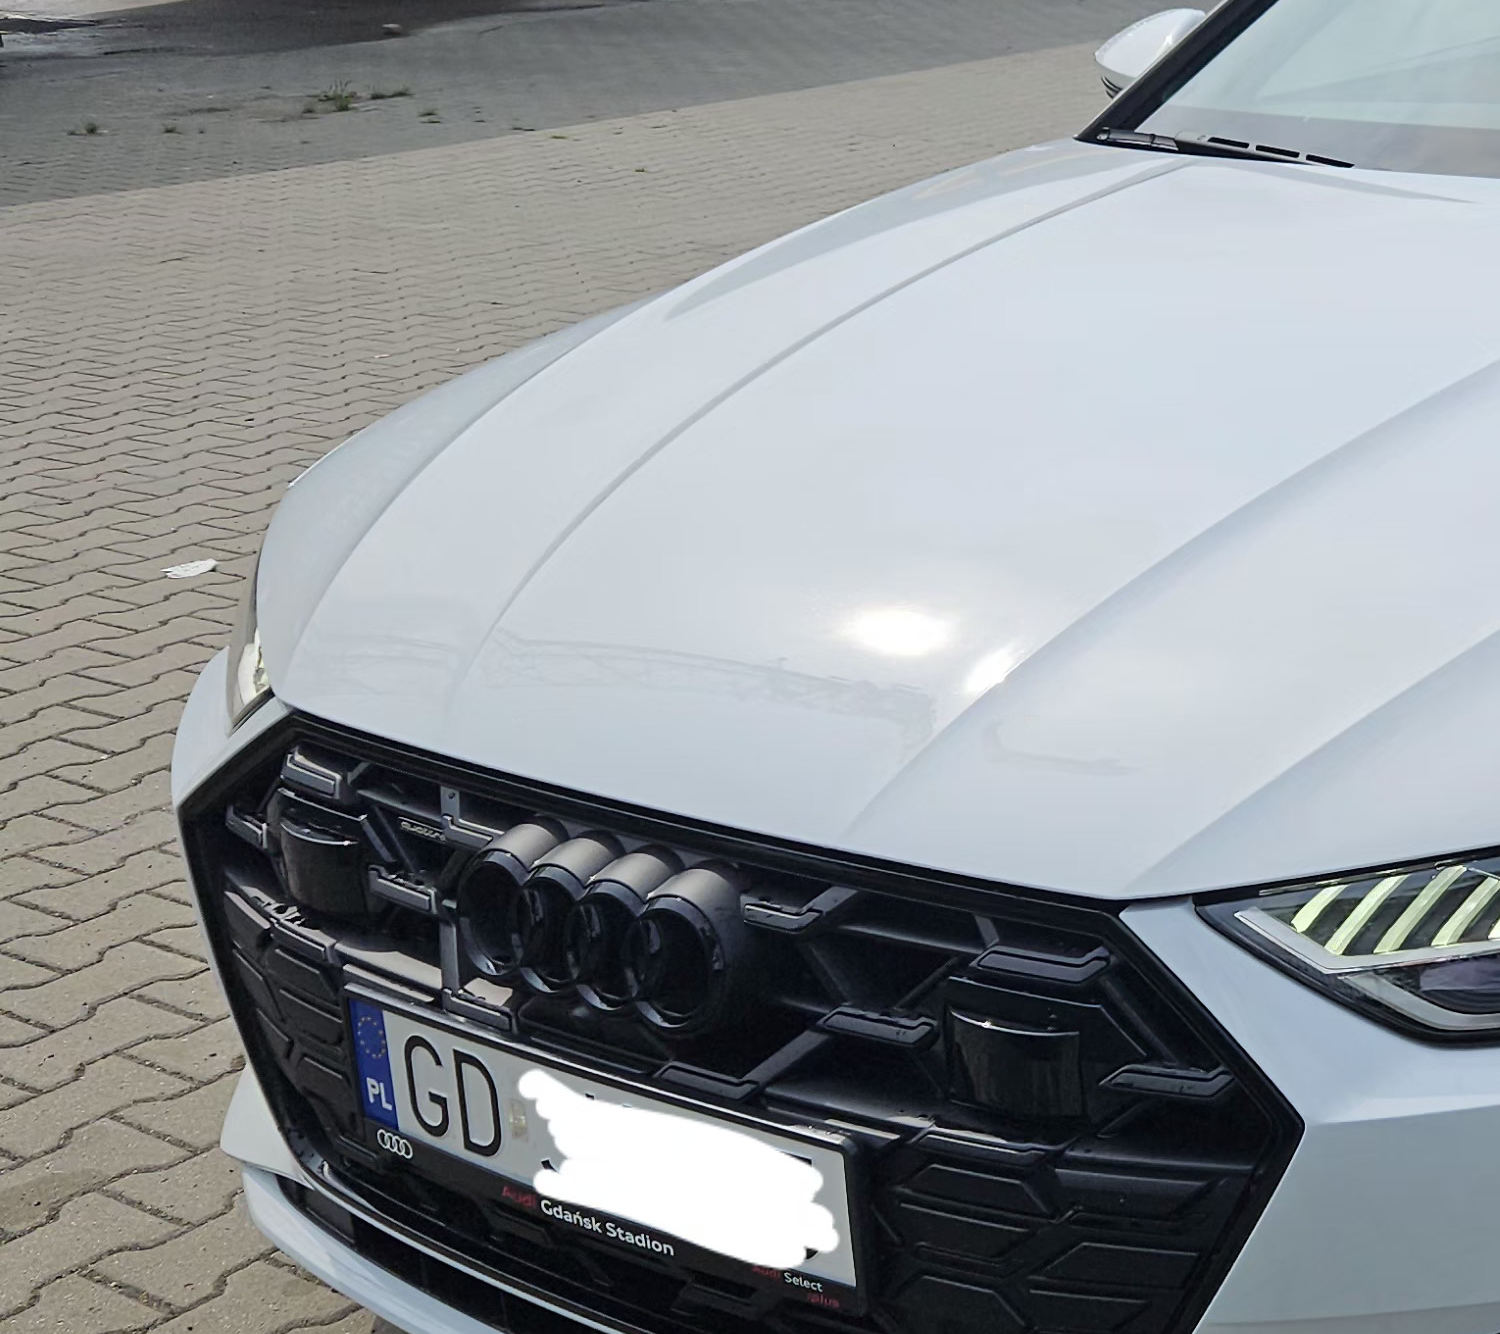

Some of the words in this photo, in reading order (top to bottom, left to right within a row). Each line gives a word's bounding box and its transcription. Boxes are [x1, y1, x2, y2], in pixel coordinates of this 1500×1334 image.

[366, 1076, 393, 1111] PL
[501, 1185, 537, 1207] Audi
[540, 1199, 602, 1234] Gdańsk
[605, 1222, 675, 1256] Stadion
[783, 1271, 823, 1293] Select
